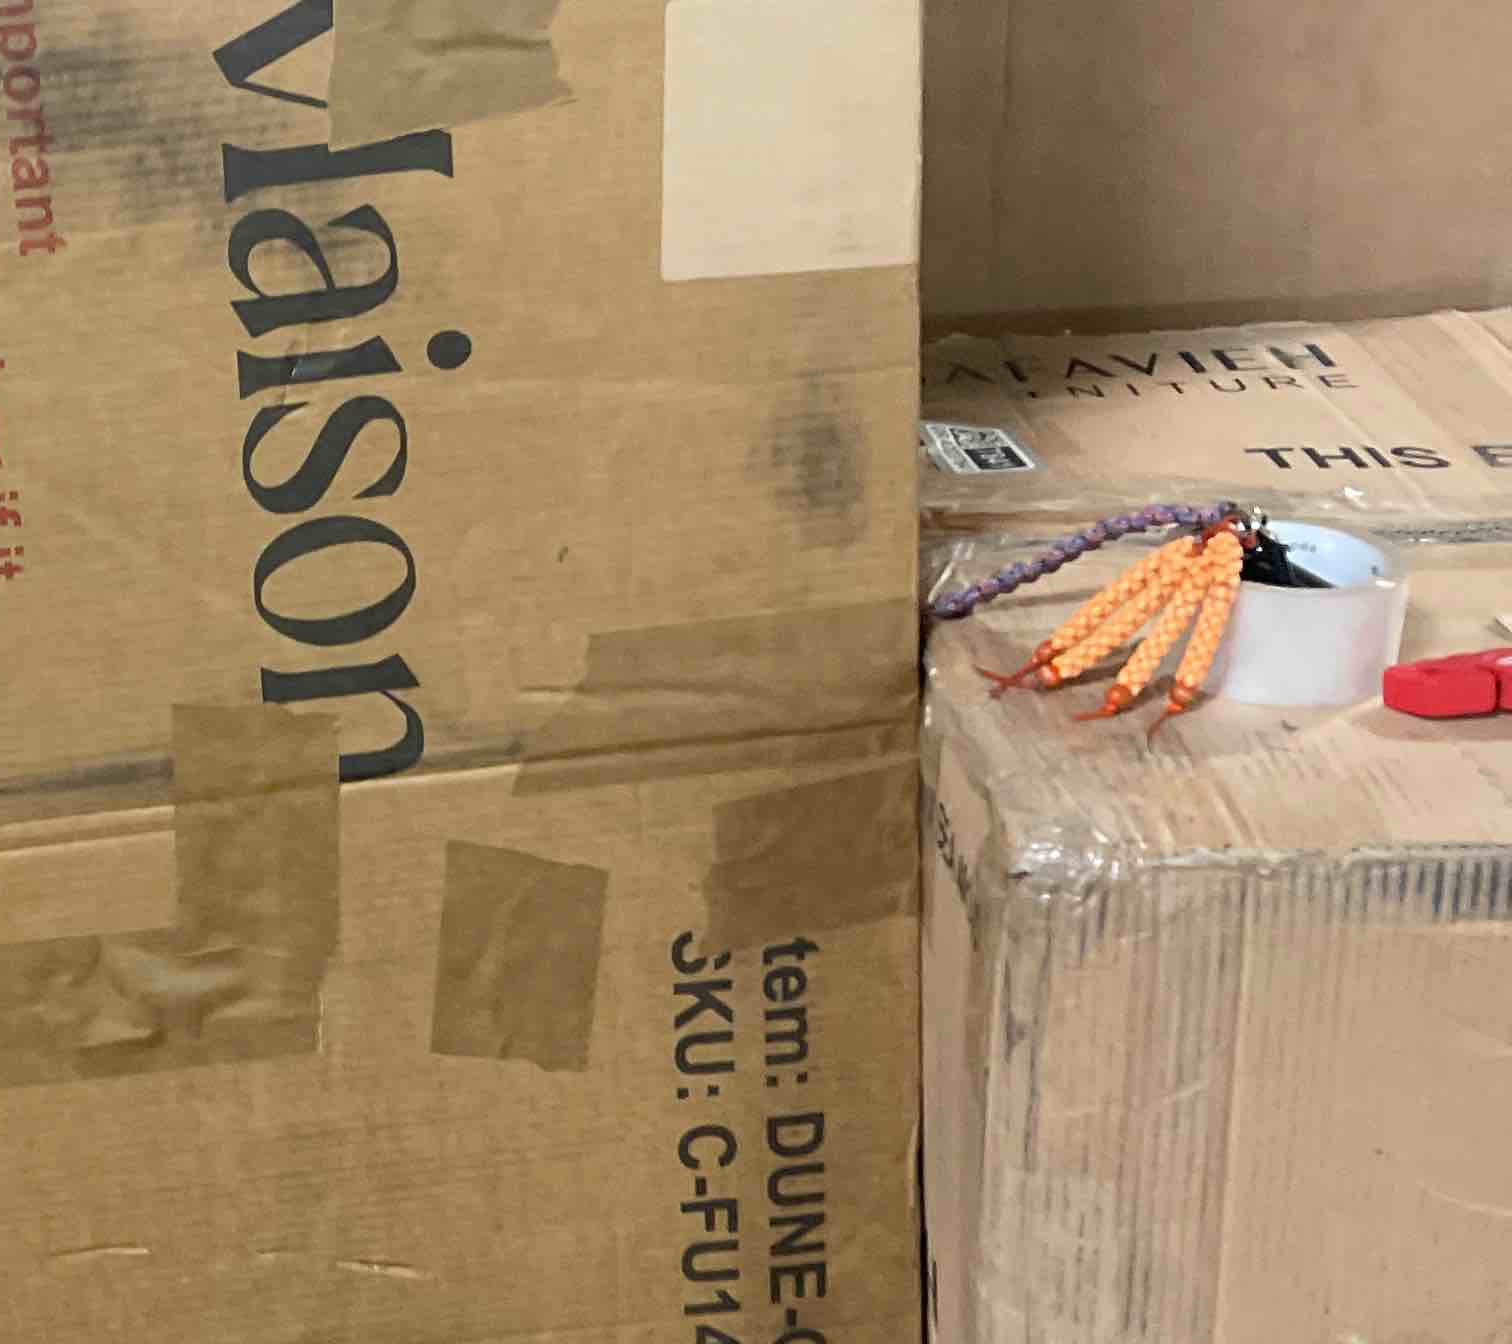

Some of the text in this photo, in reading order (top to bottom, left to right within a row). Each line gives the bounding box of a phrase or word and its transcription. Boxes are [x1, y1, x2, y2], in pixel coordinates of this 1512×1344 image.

[1245, 447, 1451, 469] THIS
[672, 931, 735, 1099] SKU:
[762, 937, 823, 1088] tem:
